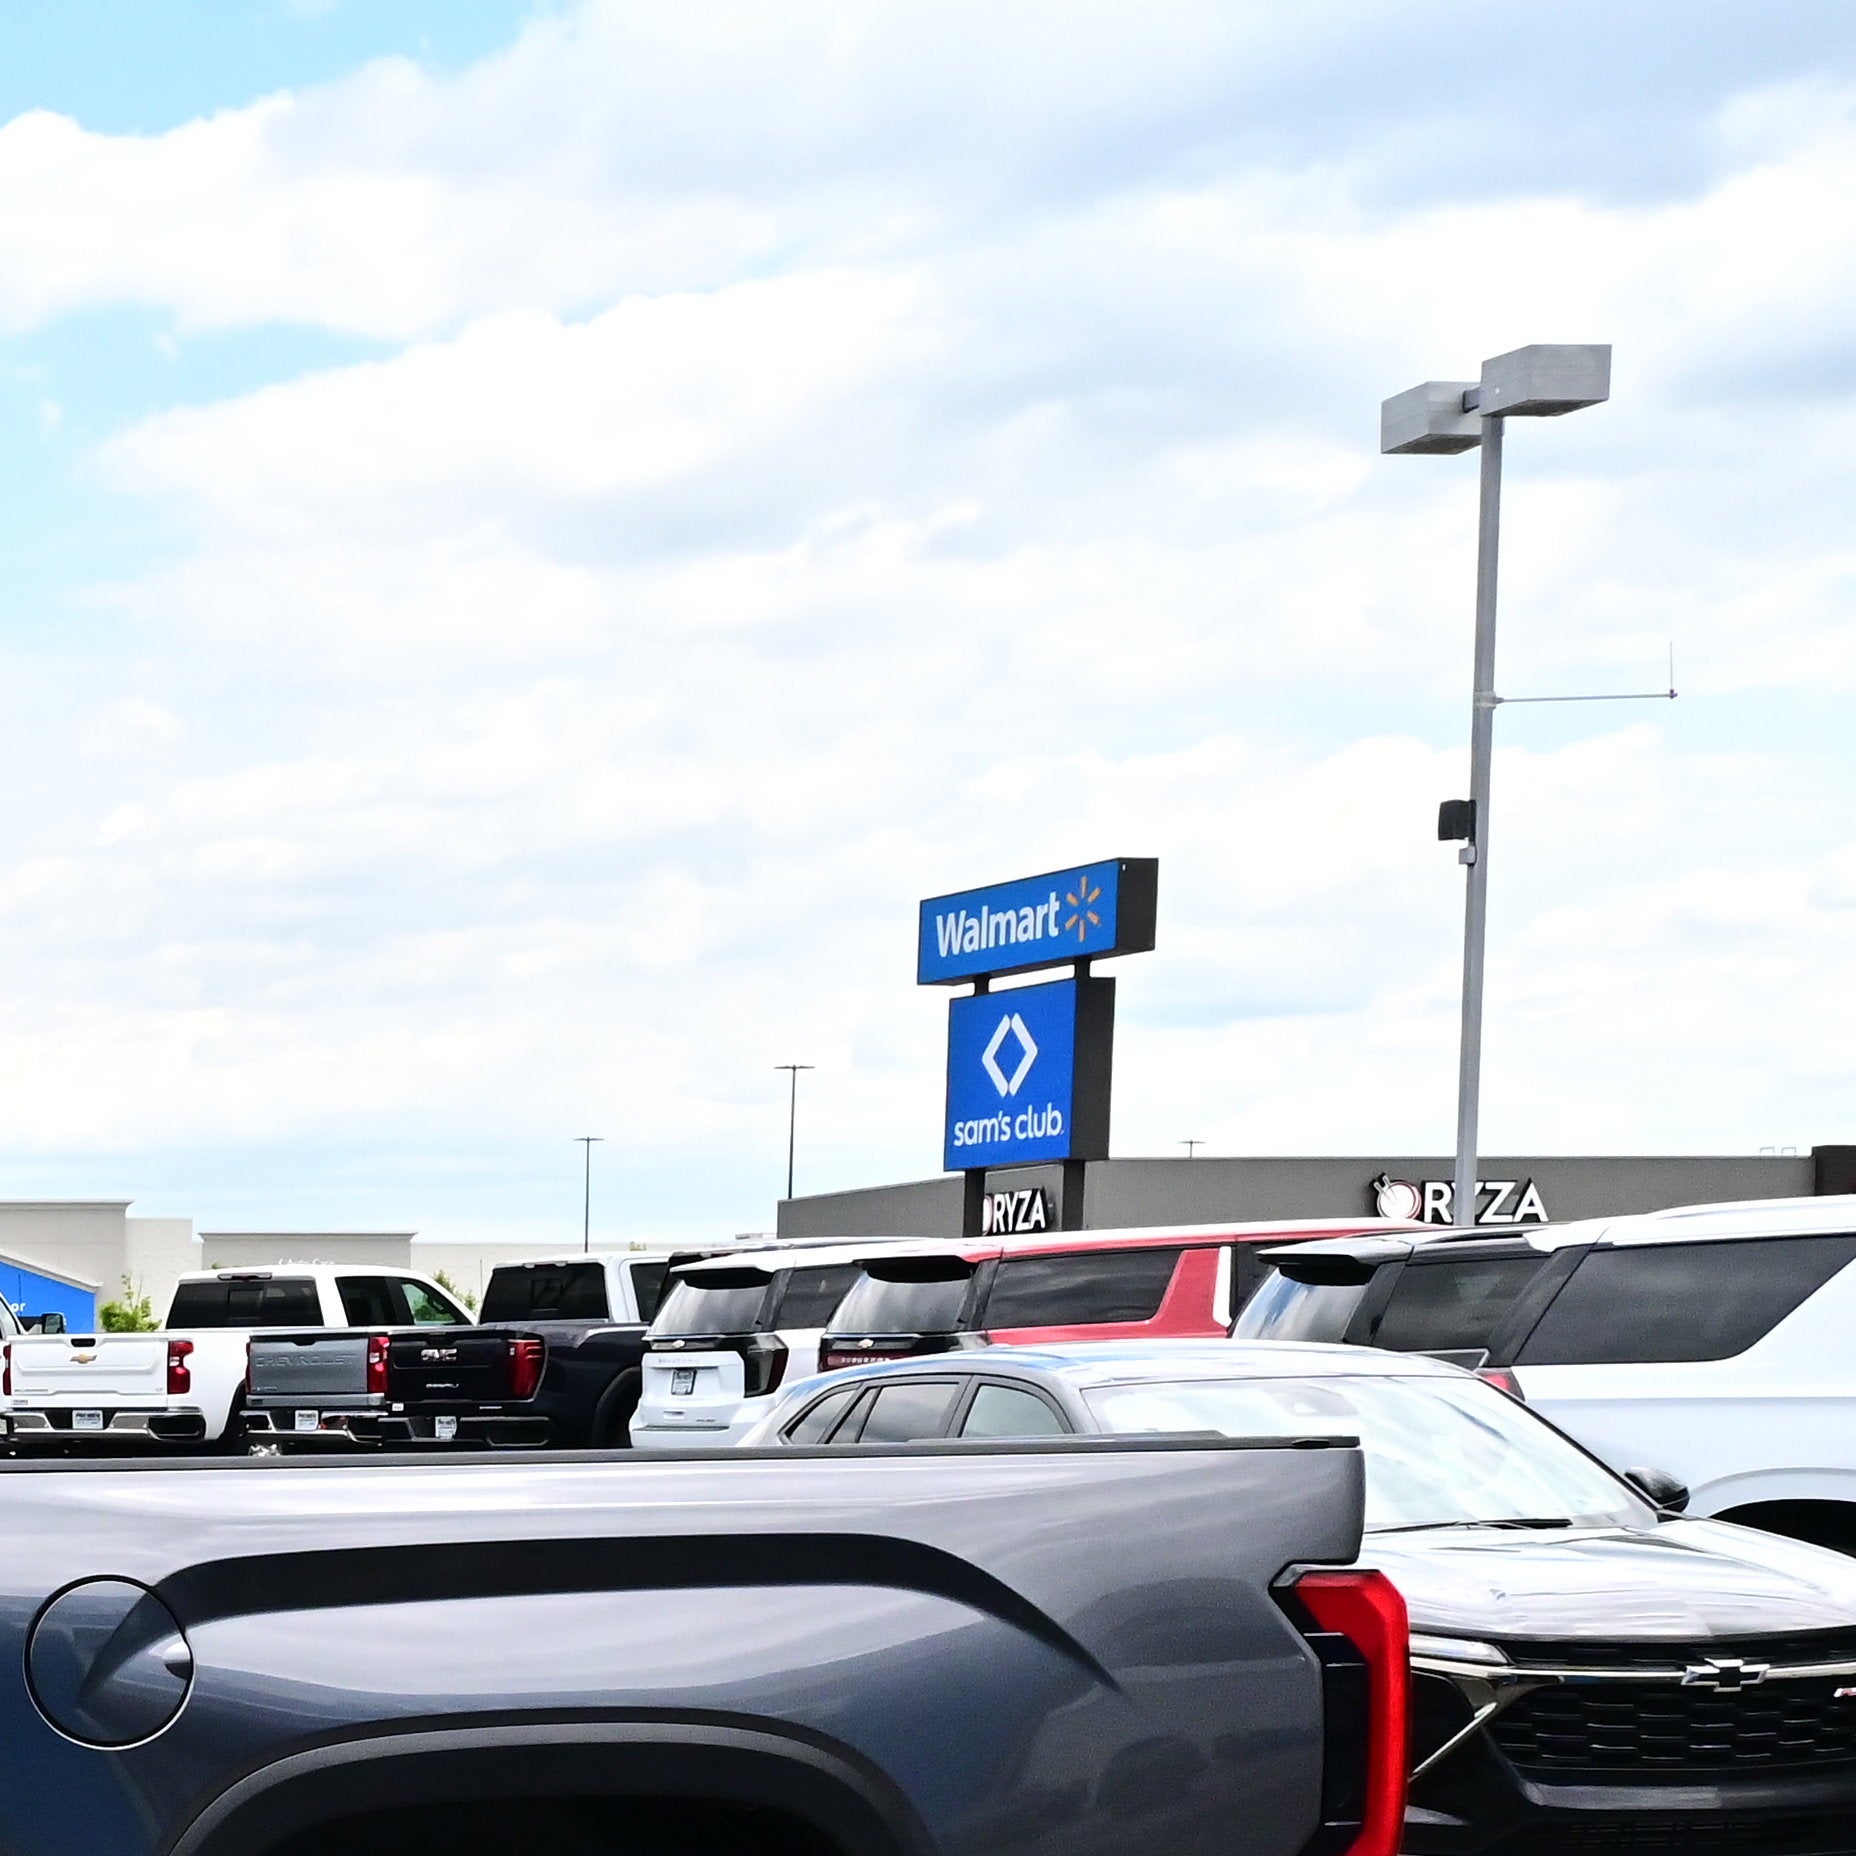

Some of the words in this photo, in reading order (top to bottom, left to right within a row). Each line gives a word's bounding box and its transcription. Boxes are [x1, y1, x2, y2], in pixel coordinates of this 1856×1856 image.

[936, 891, 1060, 957] Walmart
[953, 1110, 1010, 1146] sam's
[1015, 1102, 1062, 1139] club
[256, 1353, 357, 1367] CHEVROLET
